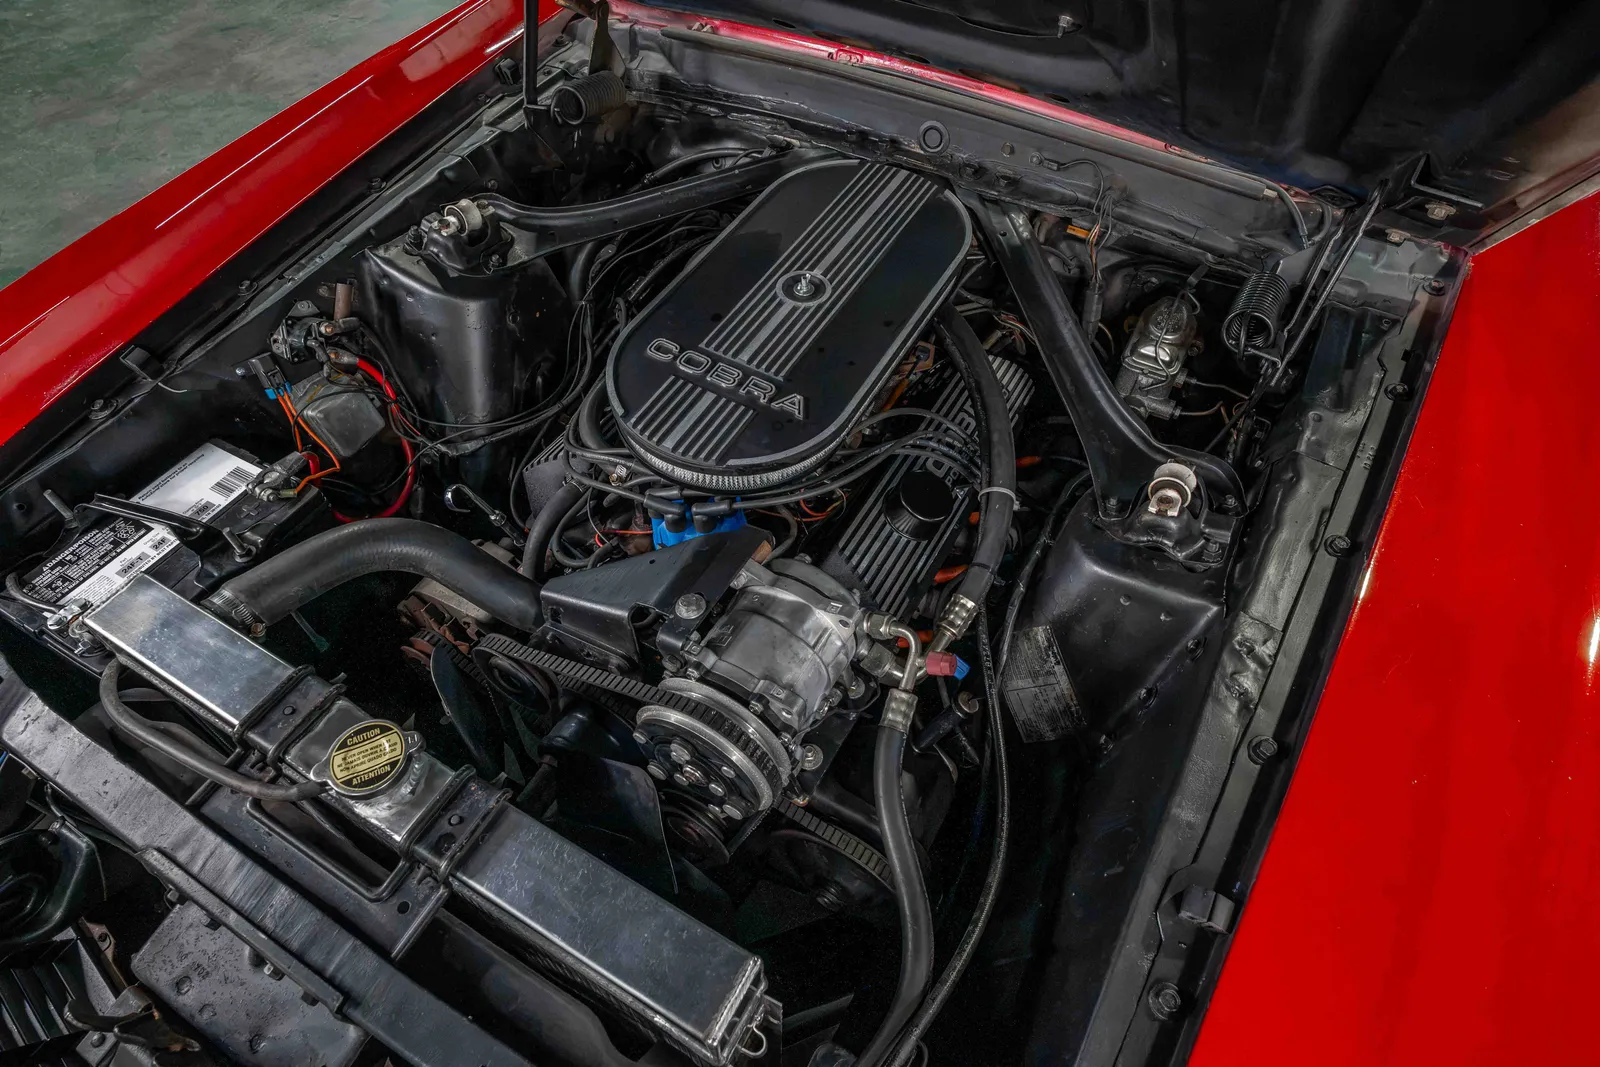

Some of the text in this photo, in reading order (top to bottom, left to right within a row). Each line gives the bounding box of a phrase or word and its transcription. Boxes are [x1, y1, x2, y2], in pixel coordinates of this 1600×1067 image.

[646, 337, 805, 421] COBRA
[195, 505, 208, 515] 750
[153, 538, 166, 549] 24F
[122, 556, 143, 573] 24F-T
[347, 728, 380, 746] CAUTION
[352, 765, 390, 785] ATTENTION
